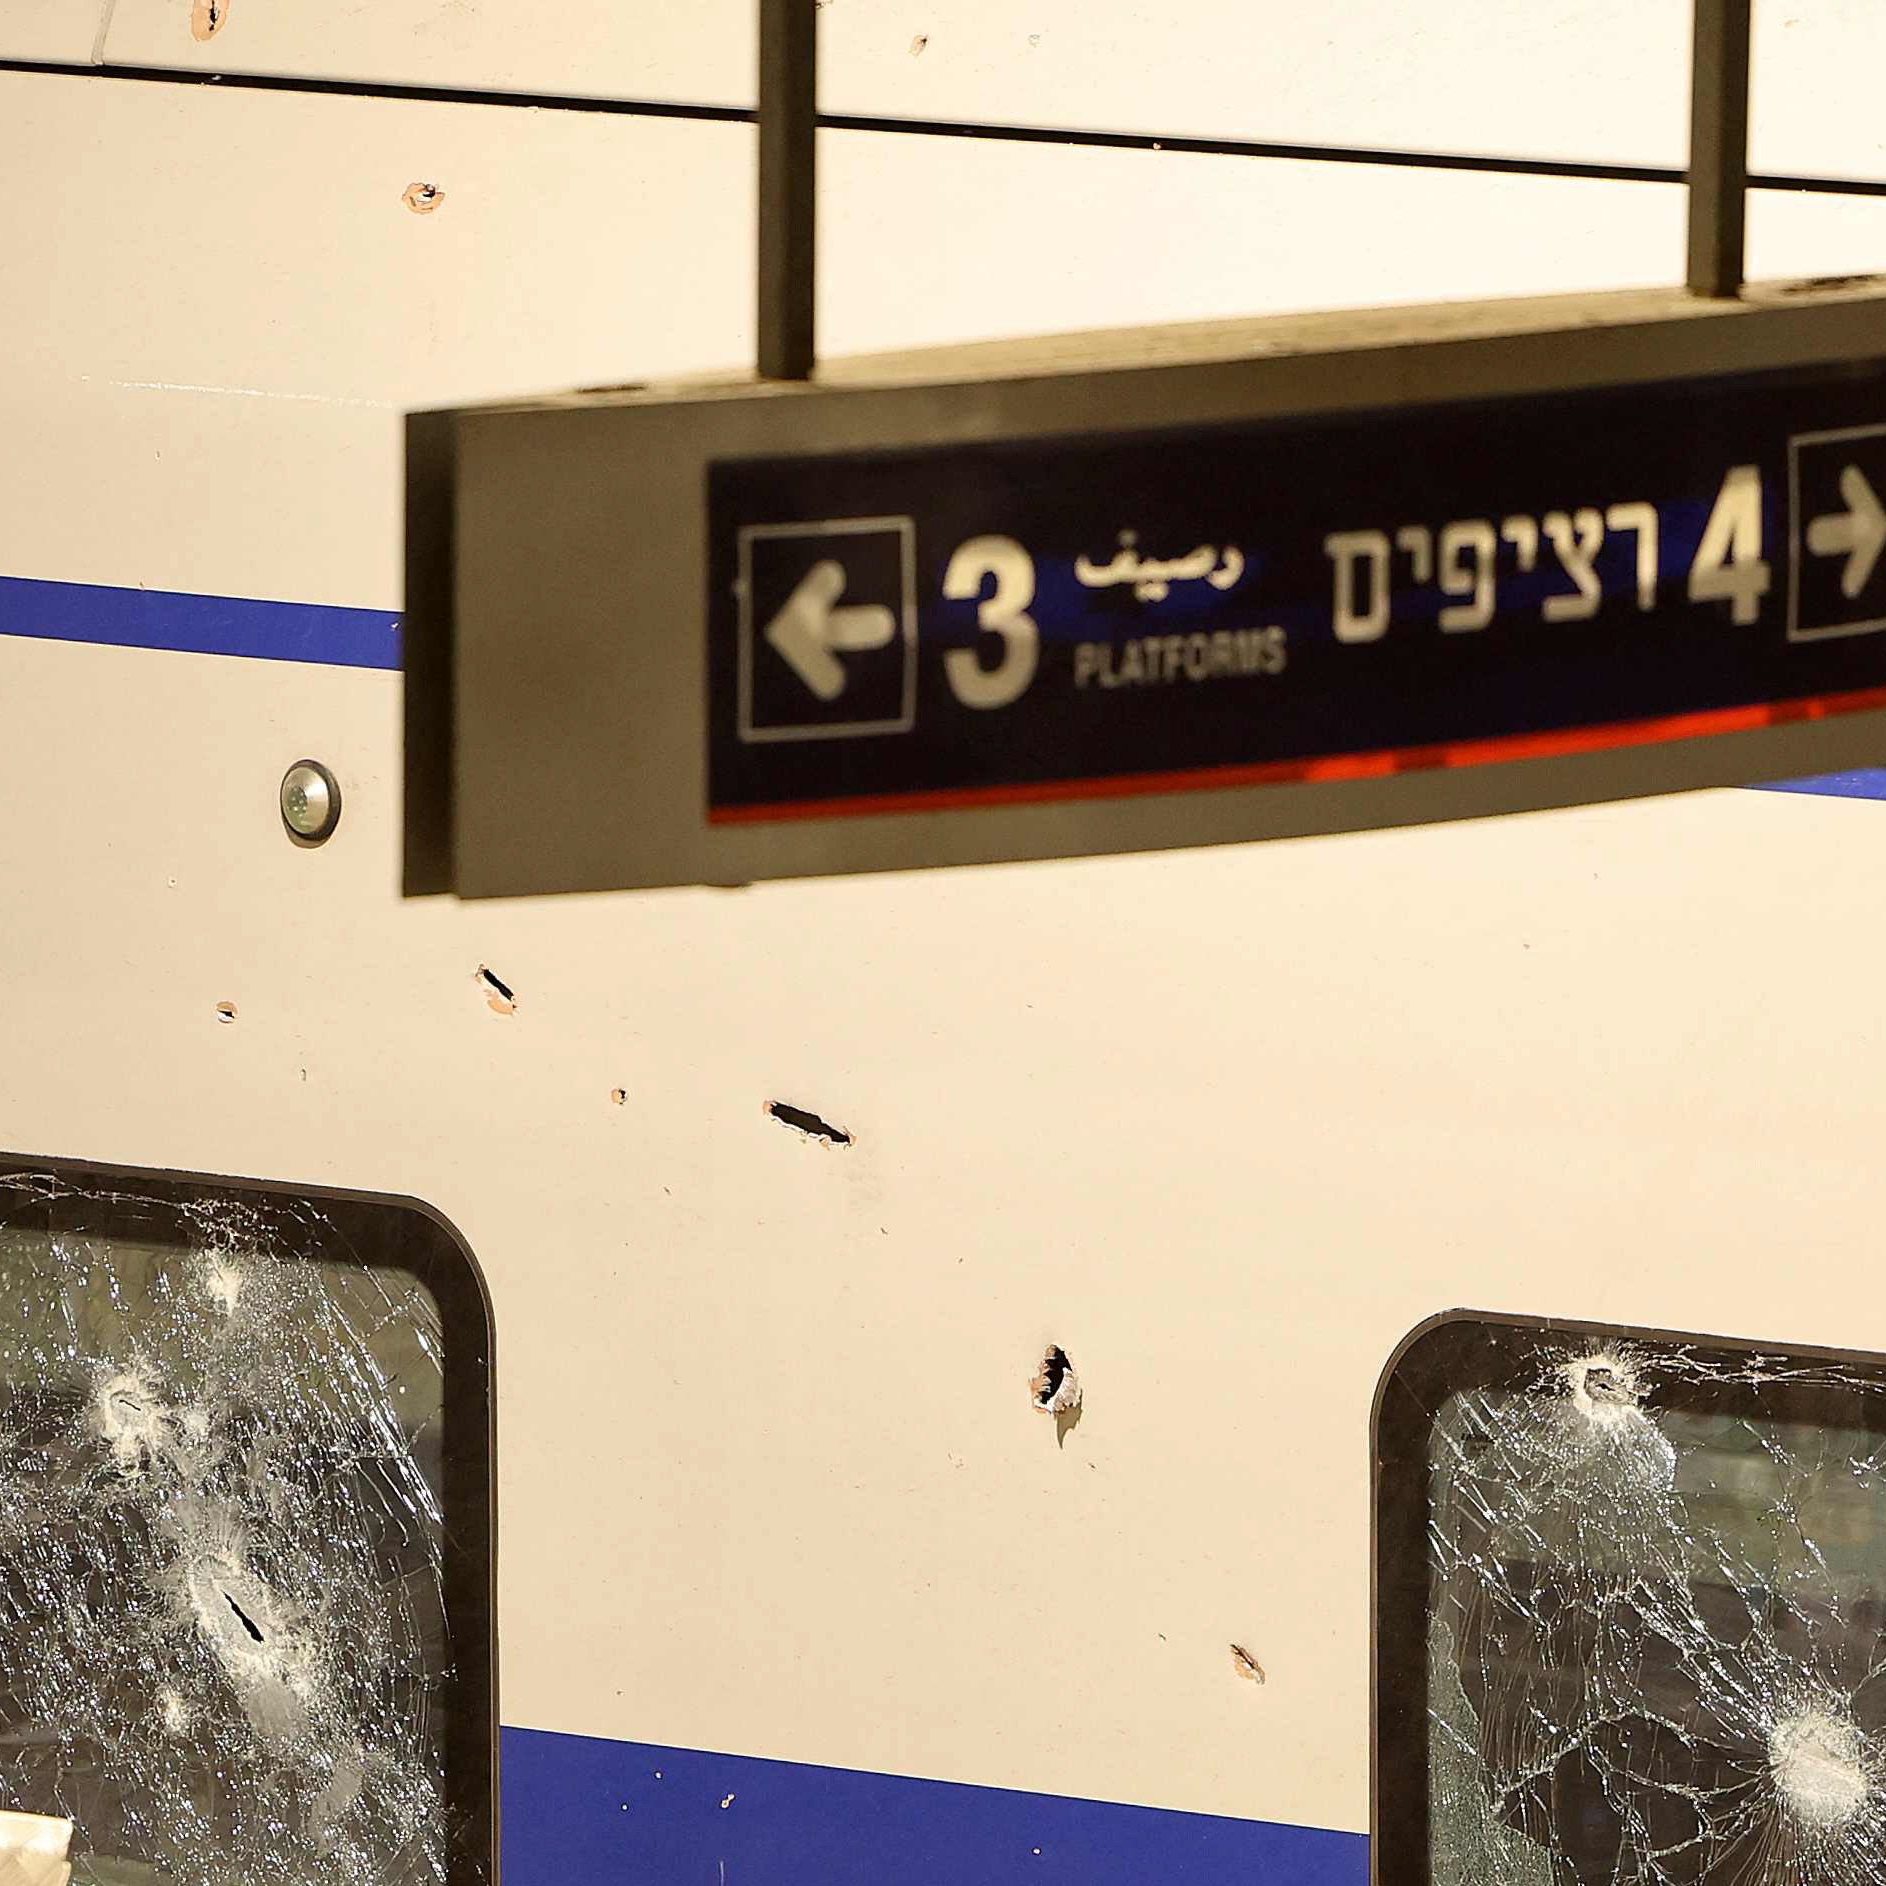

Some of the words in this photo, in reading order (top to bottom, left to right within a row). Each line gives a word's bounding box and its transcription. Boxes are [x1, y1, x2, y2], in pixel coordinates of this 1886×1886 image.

[1074, 528, 1246, 603] رصيف
[1322, 501, 1659, 644] רציפים
[1686, 464, 1771, 627] 4
[941, 533, 1040, 711] 3
[1073, 625, 1288, 690] PLATFORMS
